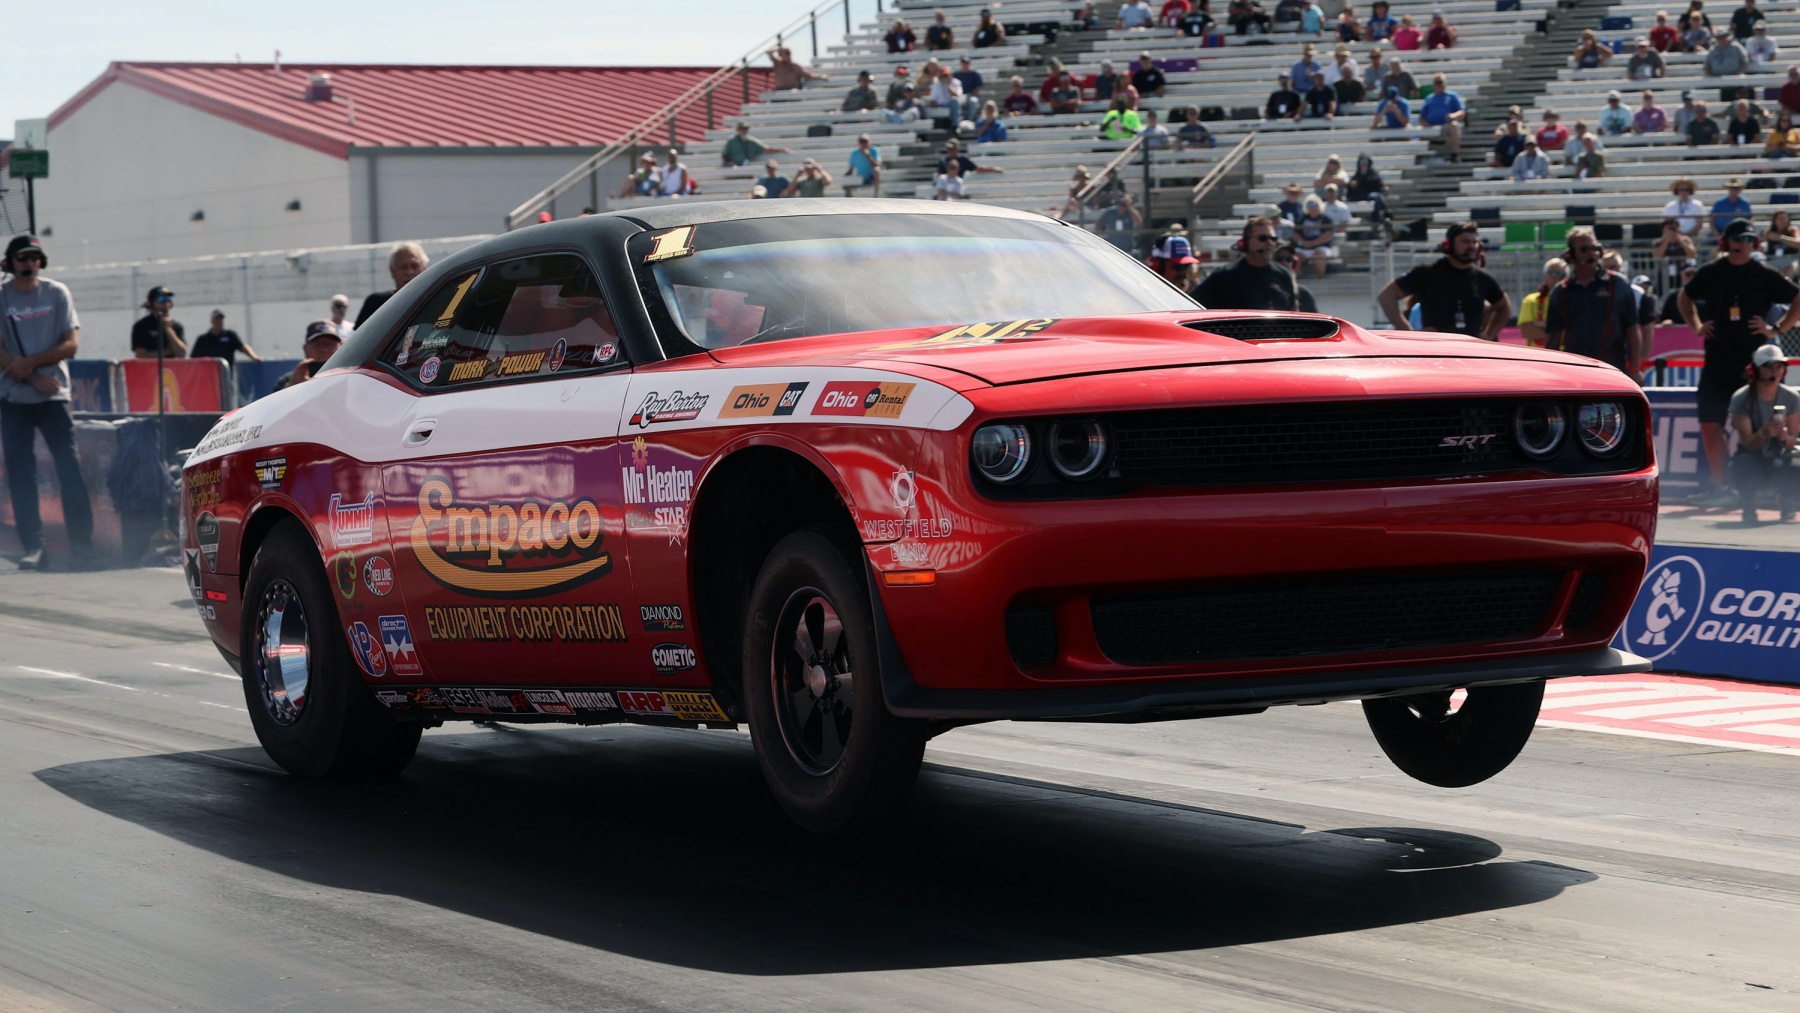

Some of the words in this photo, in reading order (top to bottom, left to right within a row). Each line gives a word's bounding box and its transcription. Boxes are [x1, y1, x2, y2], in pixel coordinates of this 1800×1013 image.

[645, 225, 696, 259] 1
[438, 273, 478, 320] 1
[733, 392, 770, 409] Ohio
[779, 390, 803, 407] CAT
[822, 391, 859, 408] Ohio
[866, 394, 878, 403] CAT
[878, 394, 906, 404] Rental
[636, 391, 668, 429] Ray
[664, 390, 709, 413] Barton
[1438, 434, 1496, 449] SRT
[622, 466, 646, 504] Mr.
[646, 465, 693, 503] Heater
[411, 480, 608, 591] Empaco
[864, 518, 952, 539] WESTFIELD
[890, 543, 929, 562] BANK
[640, 606, 682, 620] DIAMOND
[1709, 587, 1800, 622] COR
[425, 606, 510, 639] EQUIPMENT
[510, 605, 626, 640] CORPORATION
[662, 620, 685, 629] Pistons
[652, 648, 696, 667] COMETIC
[478, 690, 516, 712] Holley
[526, 692, 560, 704] LINCOLN
[564, 692, 618, 708] MOROSO
[618, 692, 667, 711] ARP
[666, 693, 718, 713] BULLET
